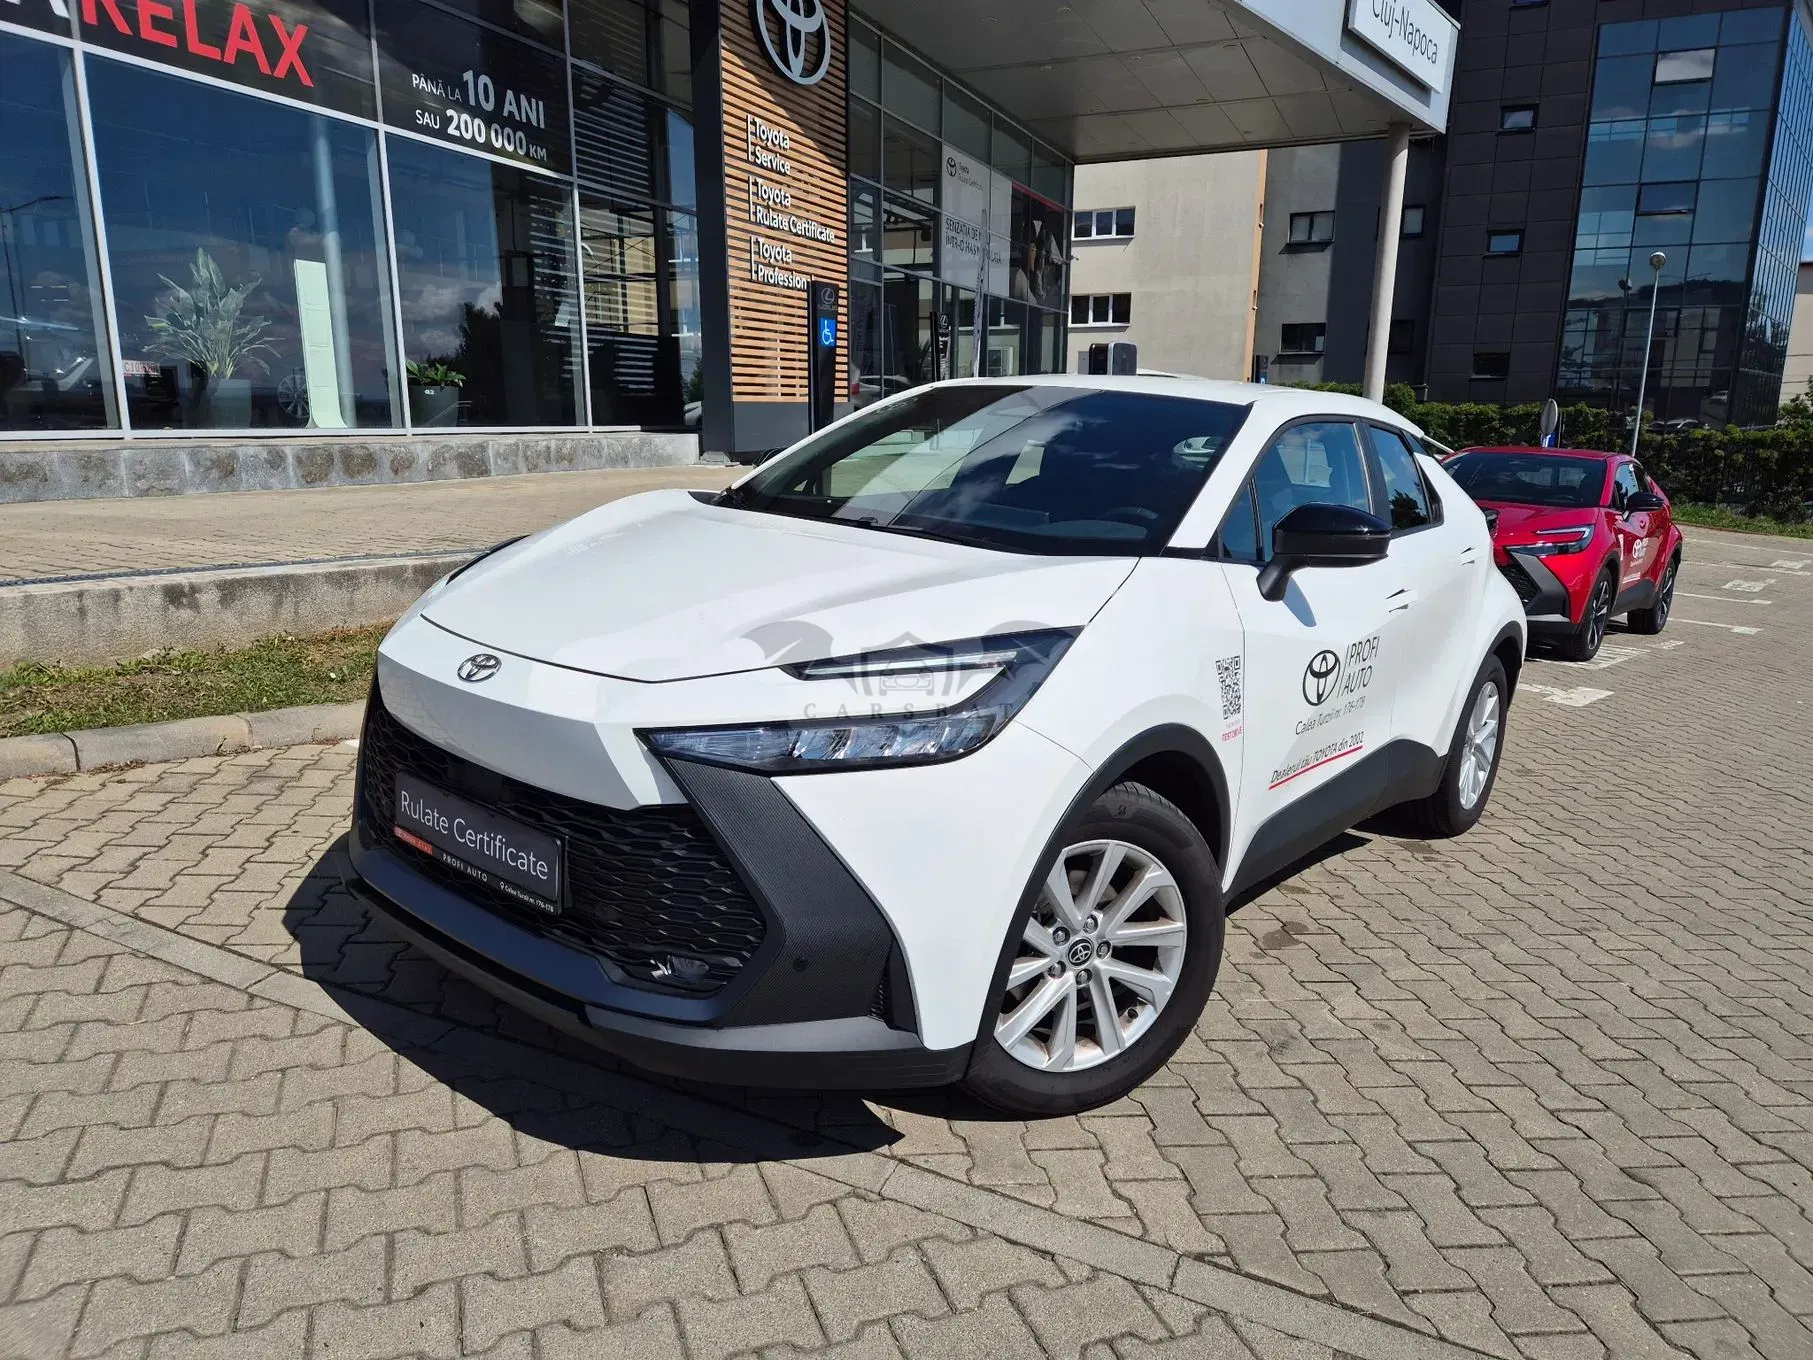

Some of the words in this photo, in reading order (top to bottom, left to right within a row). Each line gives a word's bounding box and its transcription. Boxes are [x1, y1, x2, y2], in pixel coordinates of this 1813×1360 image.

[1372, 0, 1438, 64] Cluj-Napoca
[412, 73, 445, 98] PÂNĂ
[448, 85, 463, 102] LA
[462, 69, 495, 112] 10
[502, 89, 546, 129] ANI
[415, 109, 440, 129] SAU
[446, 108, 486, 144] 200
[490, 122, 527, 155] 000
[528, 144, 547, 161] KM
[754, 117, 790, 149] Toyota
[755, 145, 791, 175] Service
[756, 178, 791, 207] Toyota
[756, 206, 789, 230] Rulate
[790, 215, 835, 243] Certificate
[757, 237, 792, 263] Toyota
[758, 265, 814, 290] Profession
[1348, 635, 1381, 668] PROFI
[1341, 665, 1373, 697] AUTO
[1295, 717, 1316, 735] Calea
[1313, 742, 1338, 764] TOYOTA
[1338, 738, 1348, 752] din
[1349, 731, 1364, 748] 2002
[401, 790, 449, 834] Rulate
[453, 818, 548, 880] Certificate
[442, 853, 464, 871] PROFI
[466, 866, 488, 882] AUTO
